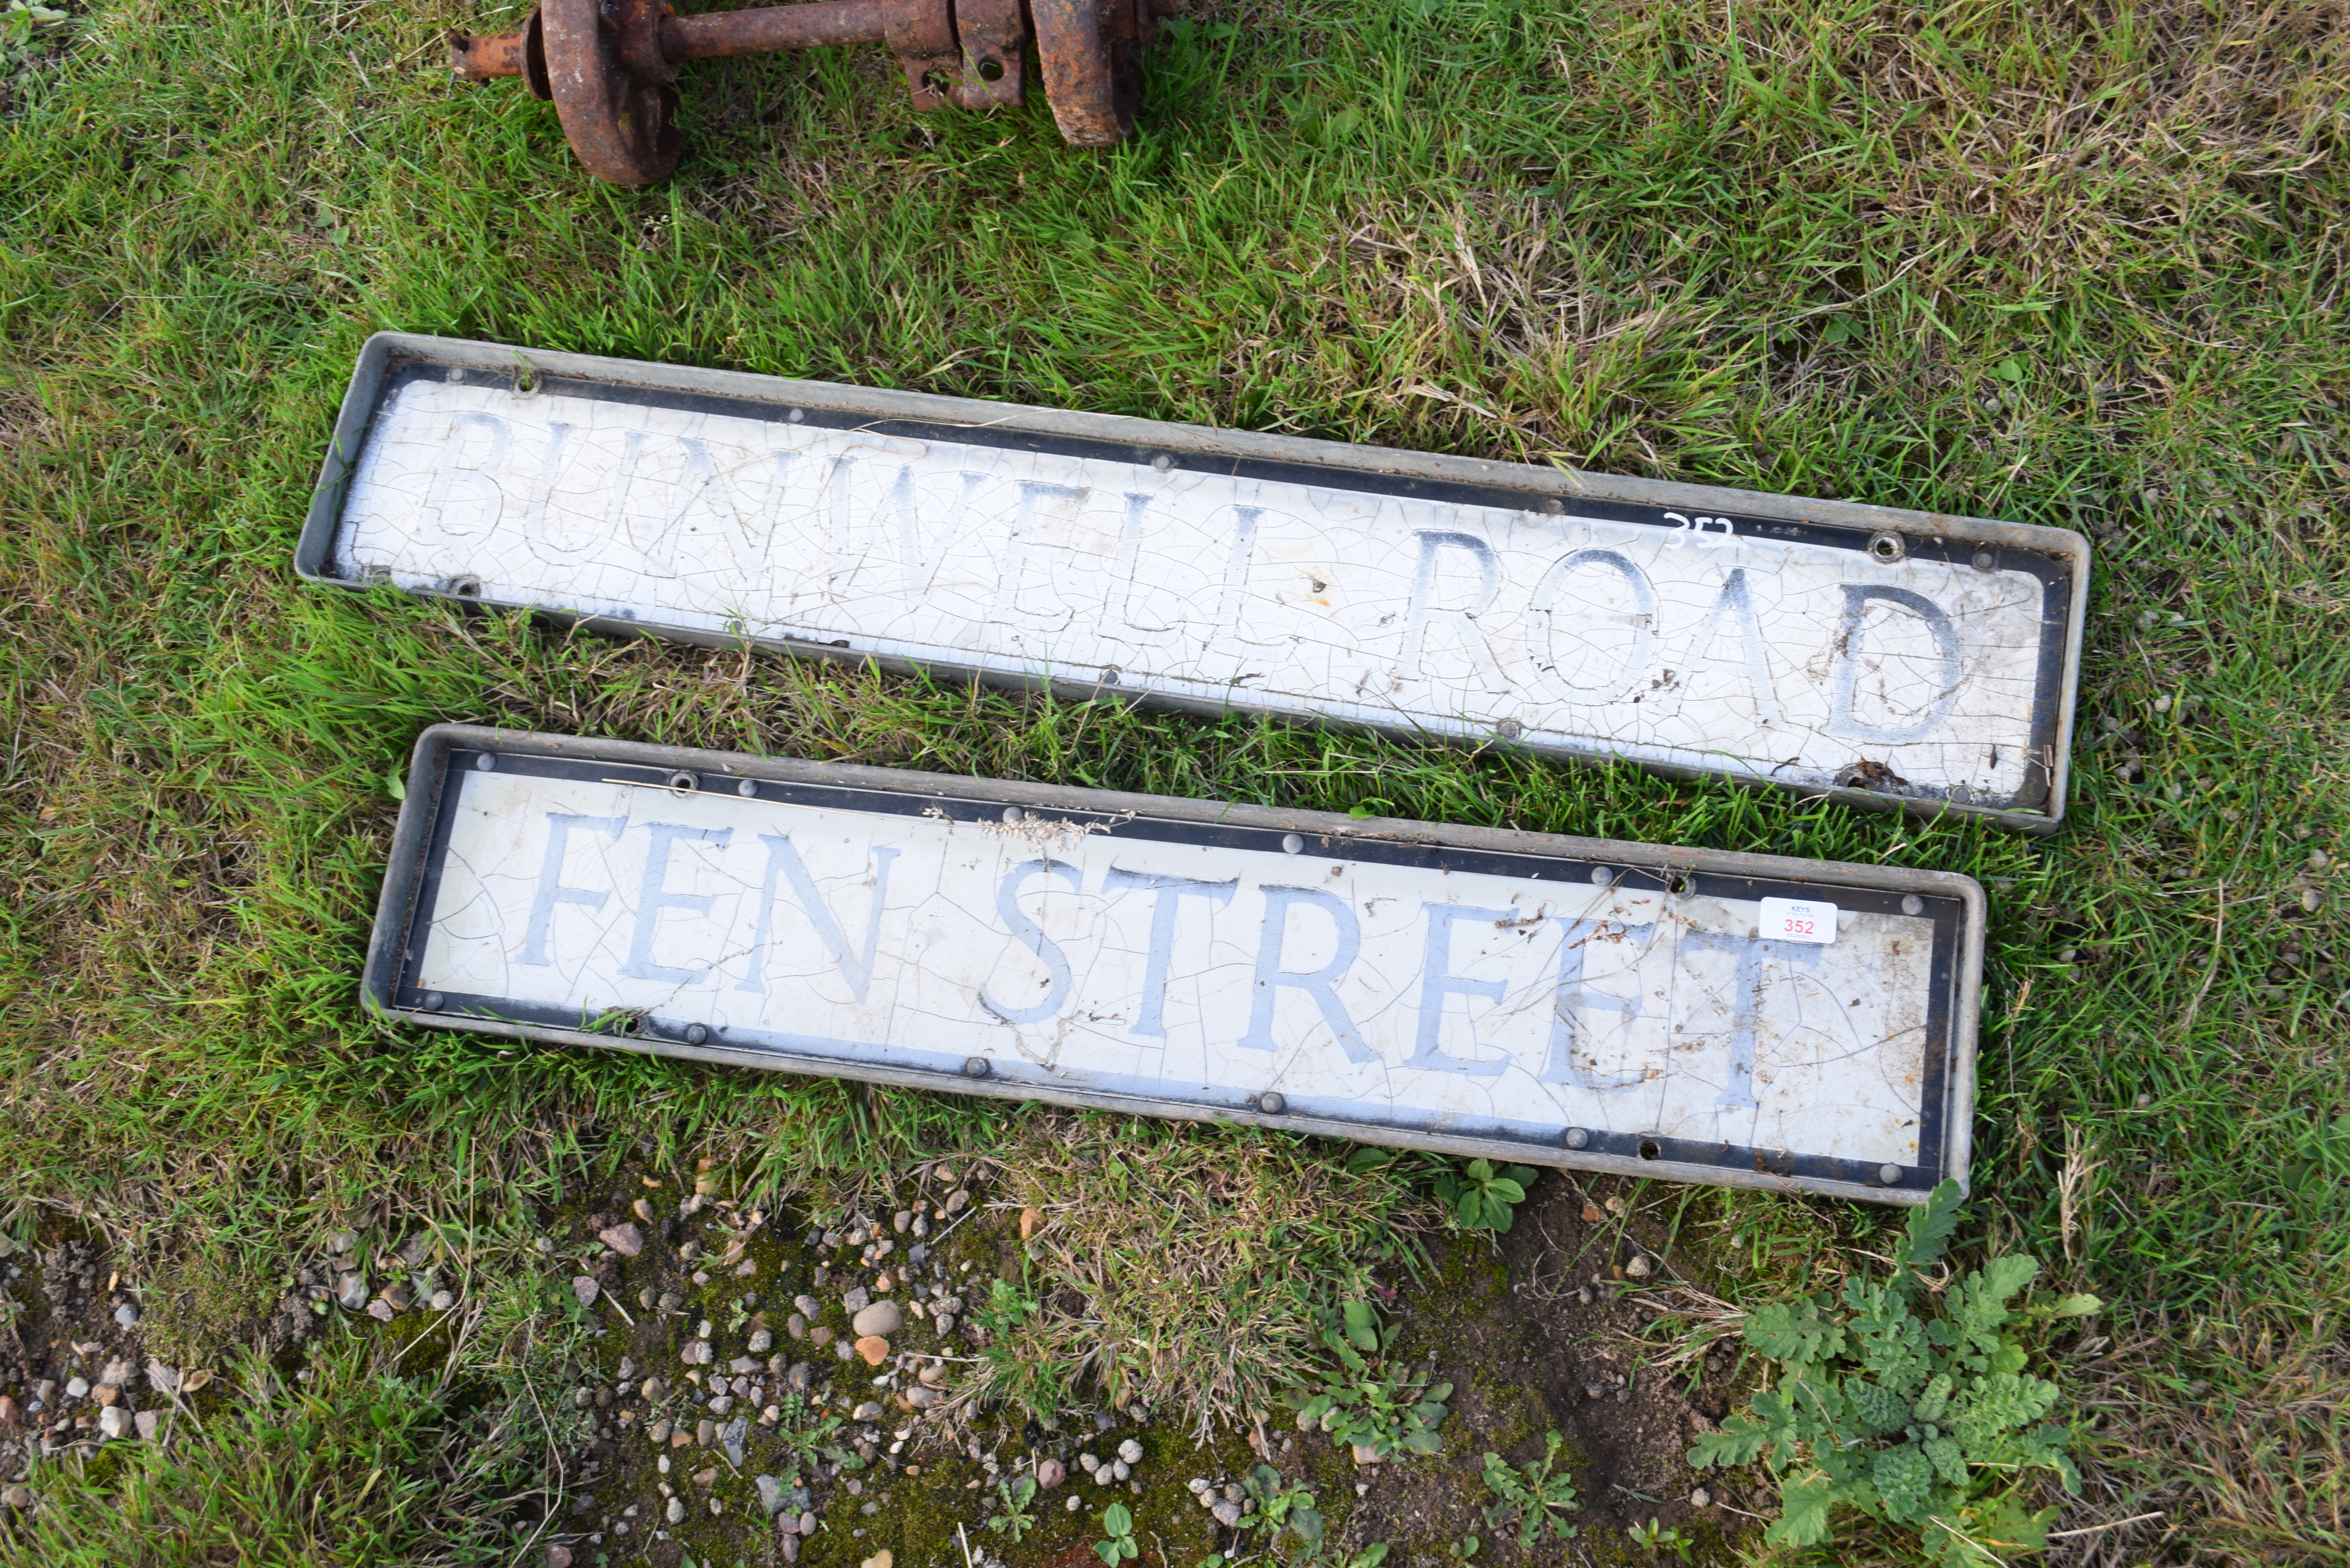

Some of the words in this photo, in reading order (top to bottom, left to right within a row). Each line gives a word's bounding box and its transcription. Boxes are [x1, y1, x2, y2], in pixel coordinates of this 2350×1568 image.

[418, 412, 1307, 658] BUNWELL
[1393, 528, 1963, 745] ROAD
[1663, 512, 1748, 549] 352
[515, 811, 901, 1006] FEN
[977, 859, 1824, 1109] STREET
[1784, 919, 1814, 935] 352
